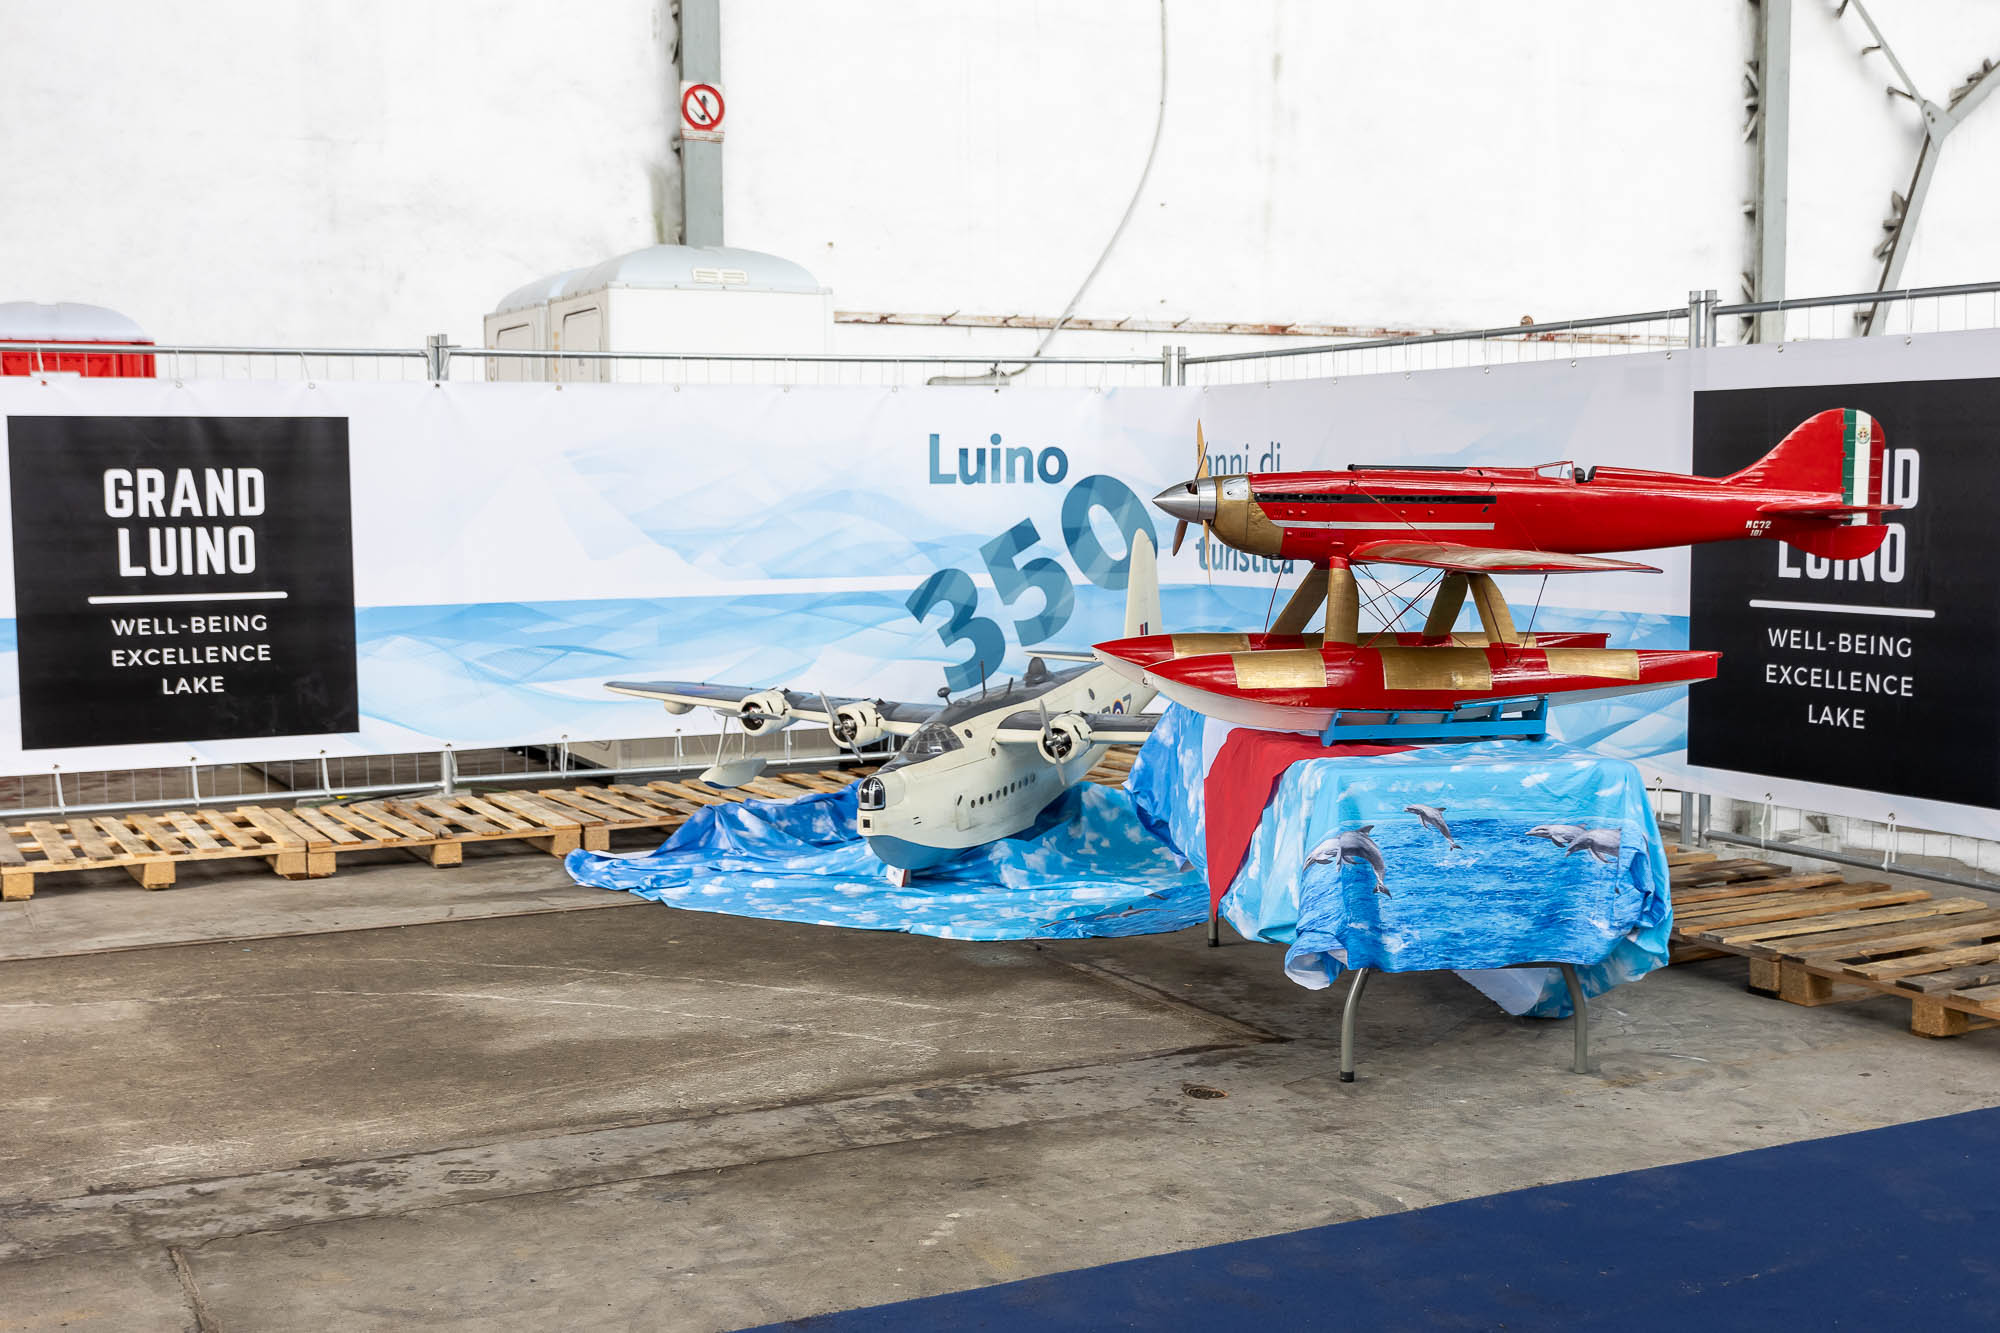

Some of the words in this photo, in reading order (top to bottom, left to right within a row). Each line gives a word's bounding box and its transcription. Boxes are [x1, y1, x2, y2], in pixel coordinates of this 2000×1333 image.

[929, 433, 1069, 485] Luino
[1259, 441, 1281, 472] di
[104, 468, 265, 517] GRAND
[118, 526, 255, 576] LUINO
[905, 474, 1158, 693] 350
[112, 615, 266, 635] WELL-BEING
[112, 645, 271, 666] EXCELLENCE
[1768, 628, 1911, 657] WELL-BEING
[163, 676, 224, 694] LAKE
[1767, 664, 1912, 696] EXCELLENCE
[1809, 705, 1864, 728] LAKE
